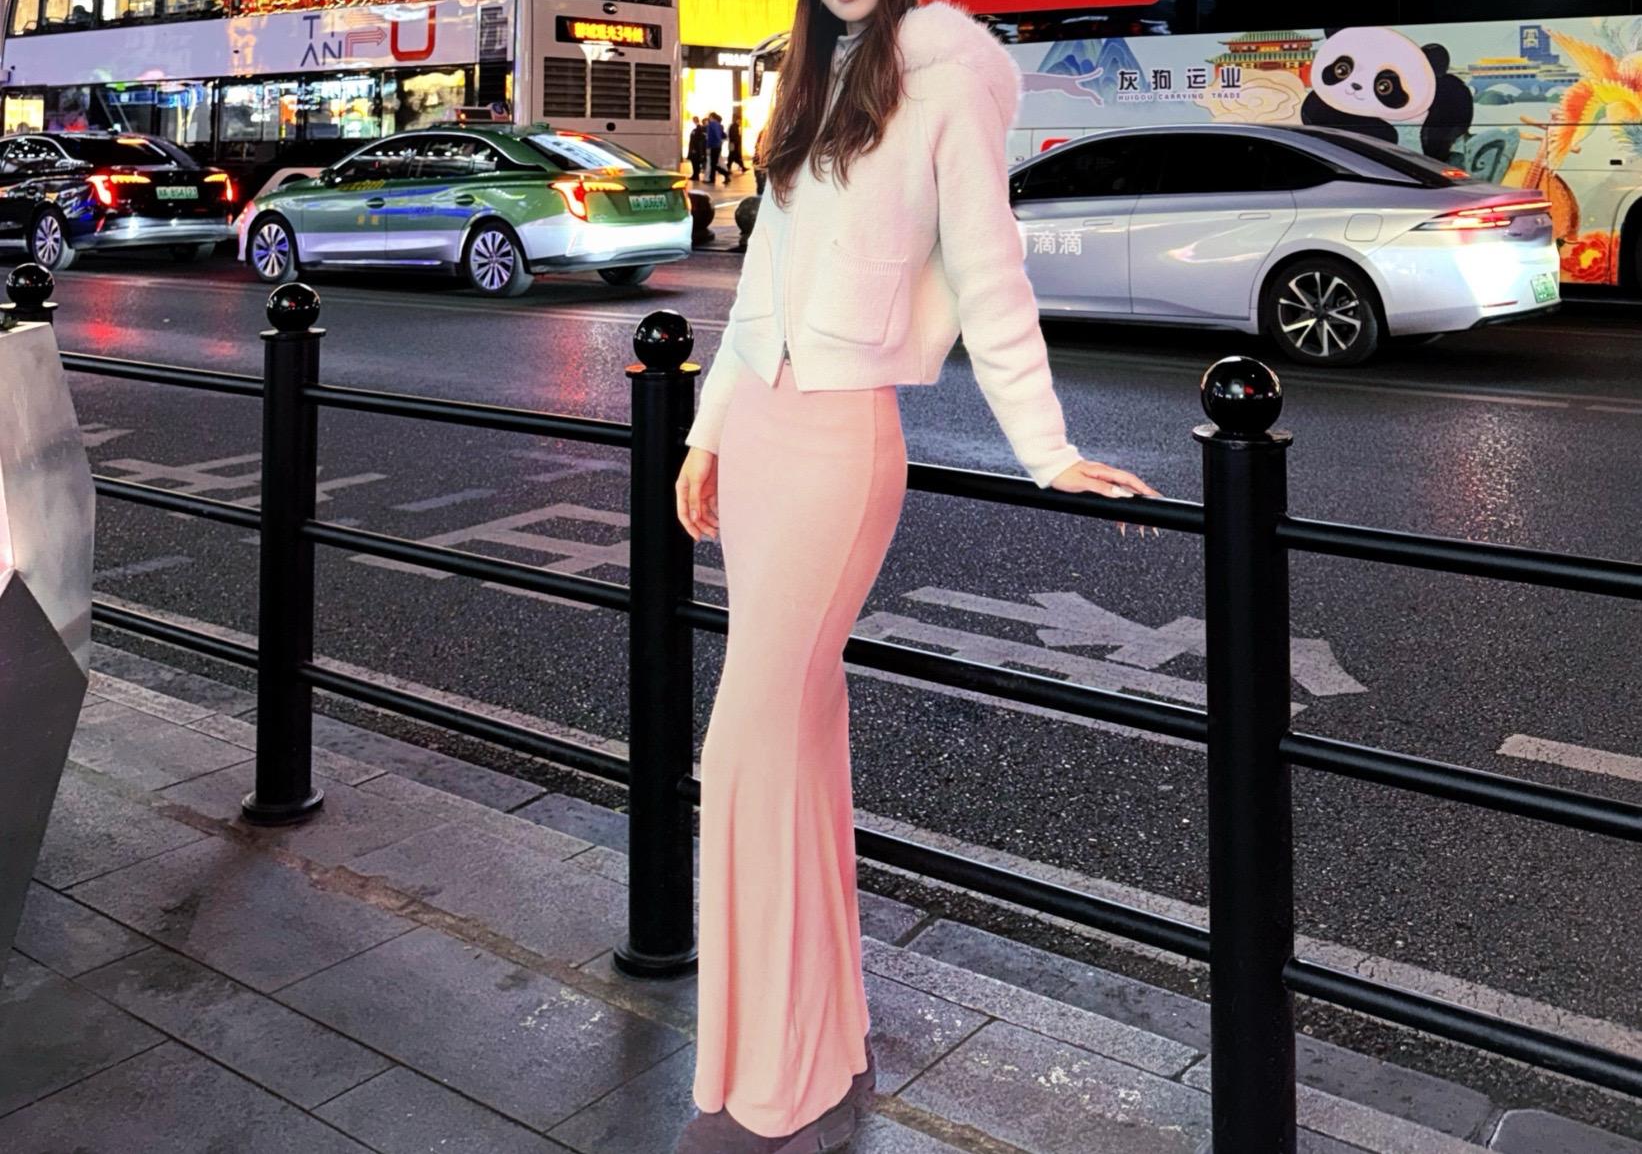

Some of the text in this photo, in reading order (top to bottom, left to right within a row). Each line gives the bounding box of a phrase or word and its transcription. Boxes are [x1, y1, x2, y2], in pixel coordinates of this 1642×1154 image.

[1118, 67, 1241, 91] 灰狗运业
[1032, 230, 1082, 255] 滴滴
